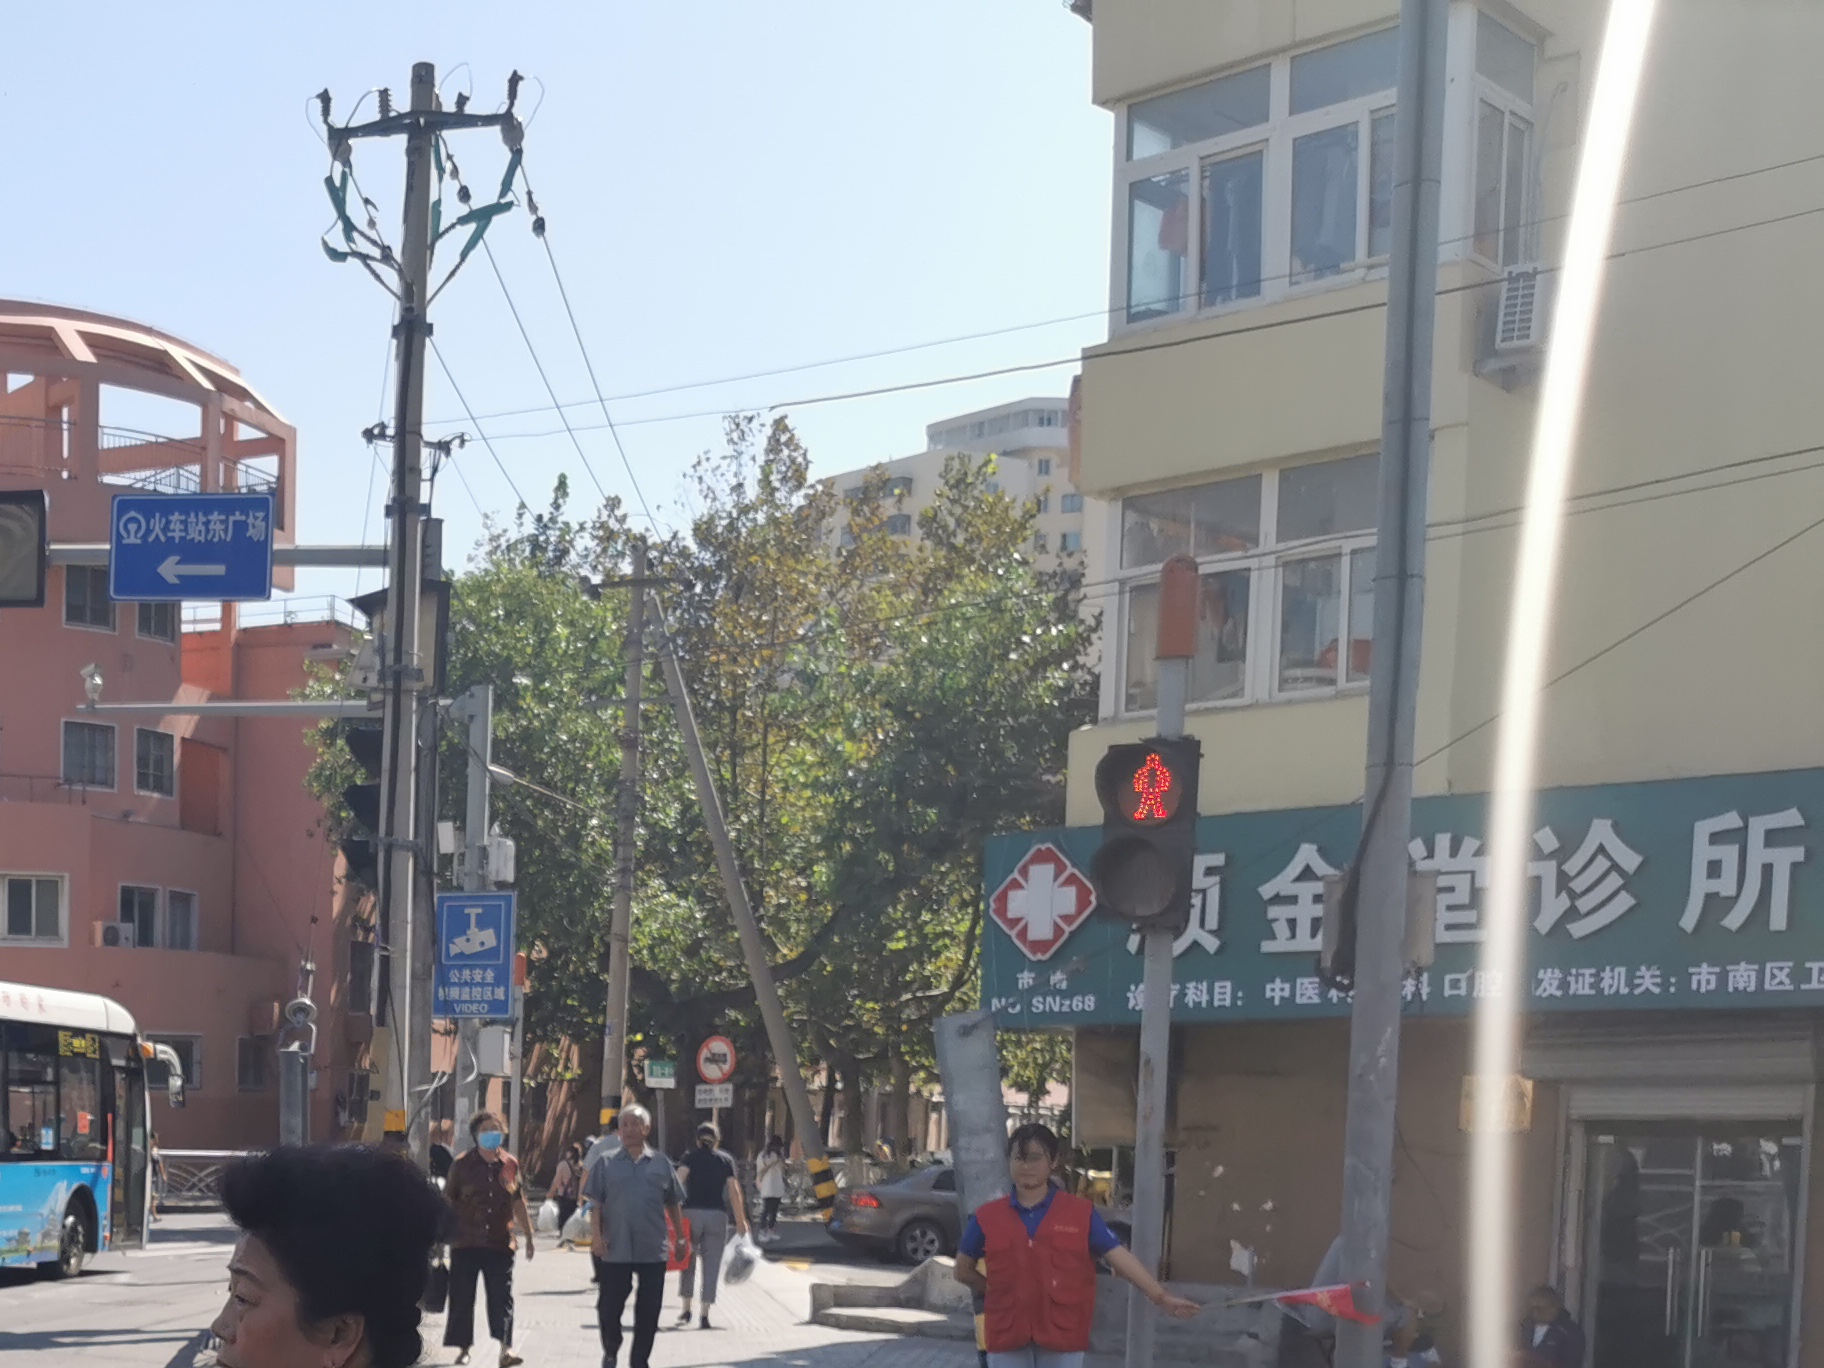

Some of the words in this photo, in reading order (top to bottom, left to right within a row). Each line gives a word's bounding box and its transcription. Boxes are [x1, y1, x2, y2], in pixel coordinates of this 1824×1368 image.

[148, 510, 266, 543] 火车站东广场
[1126, 805, 1806, 956] 金堂诊所
[448, 968, 495, 984] 公共安全
[1535, 963, 1677, 998] 发证机关:
[453, 1002, 489, 1014] VIDEO
